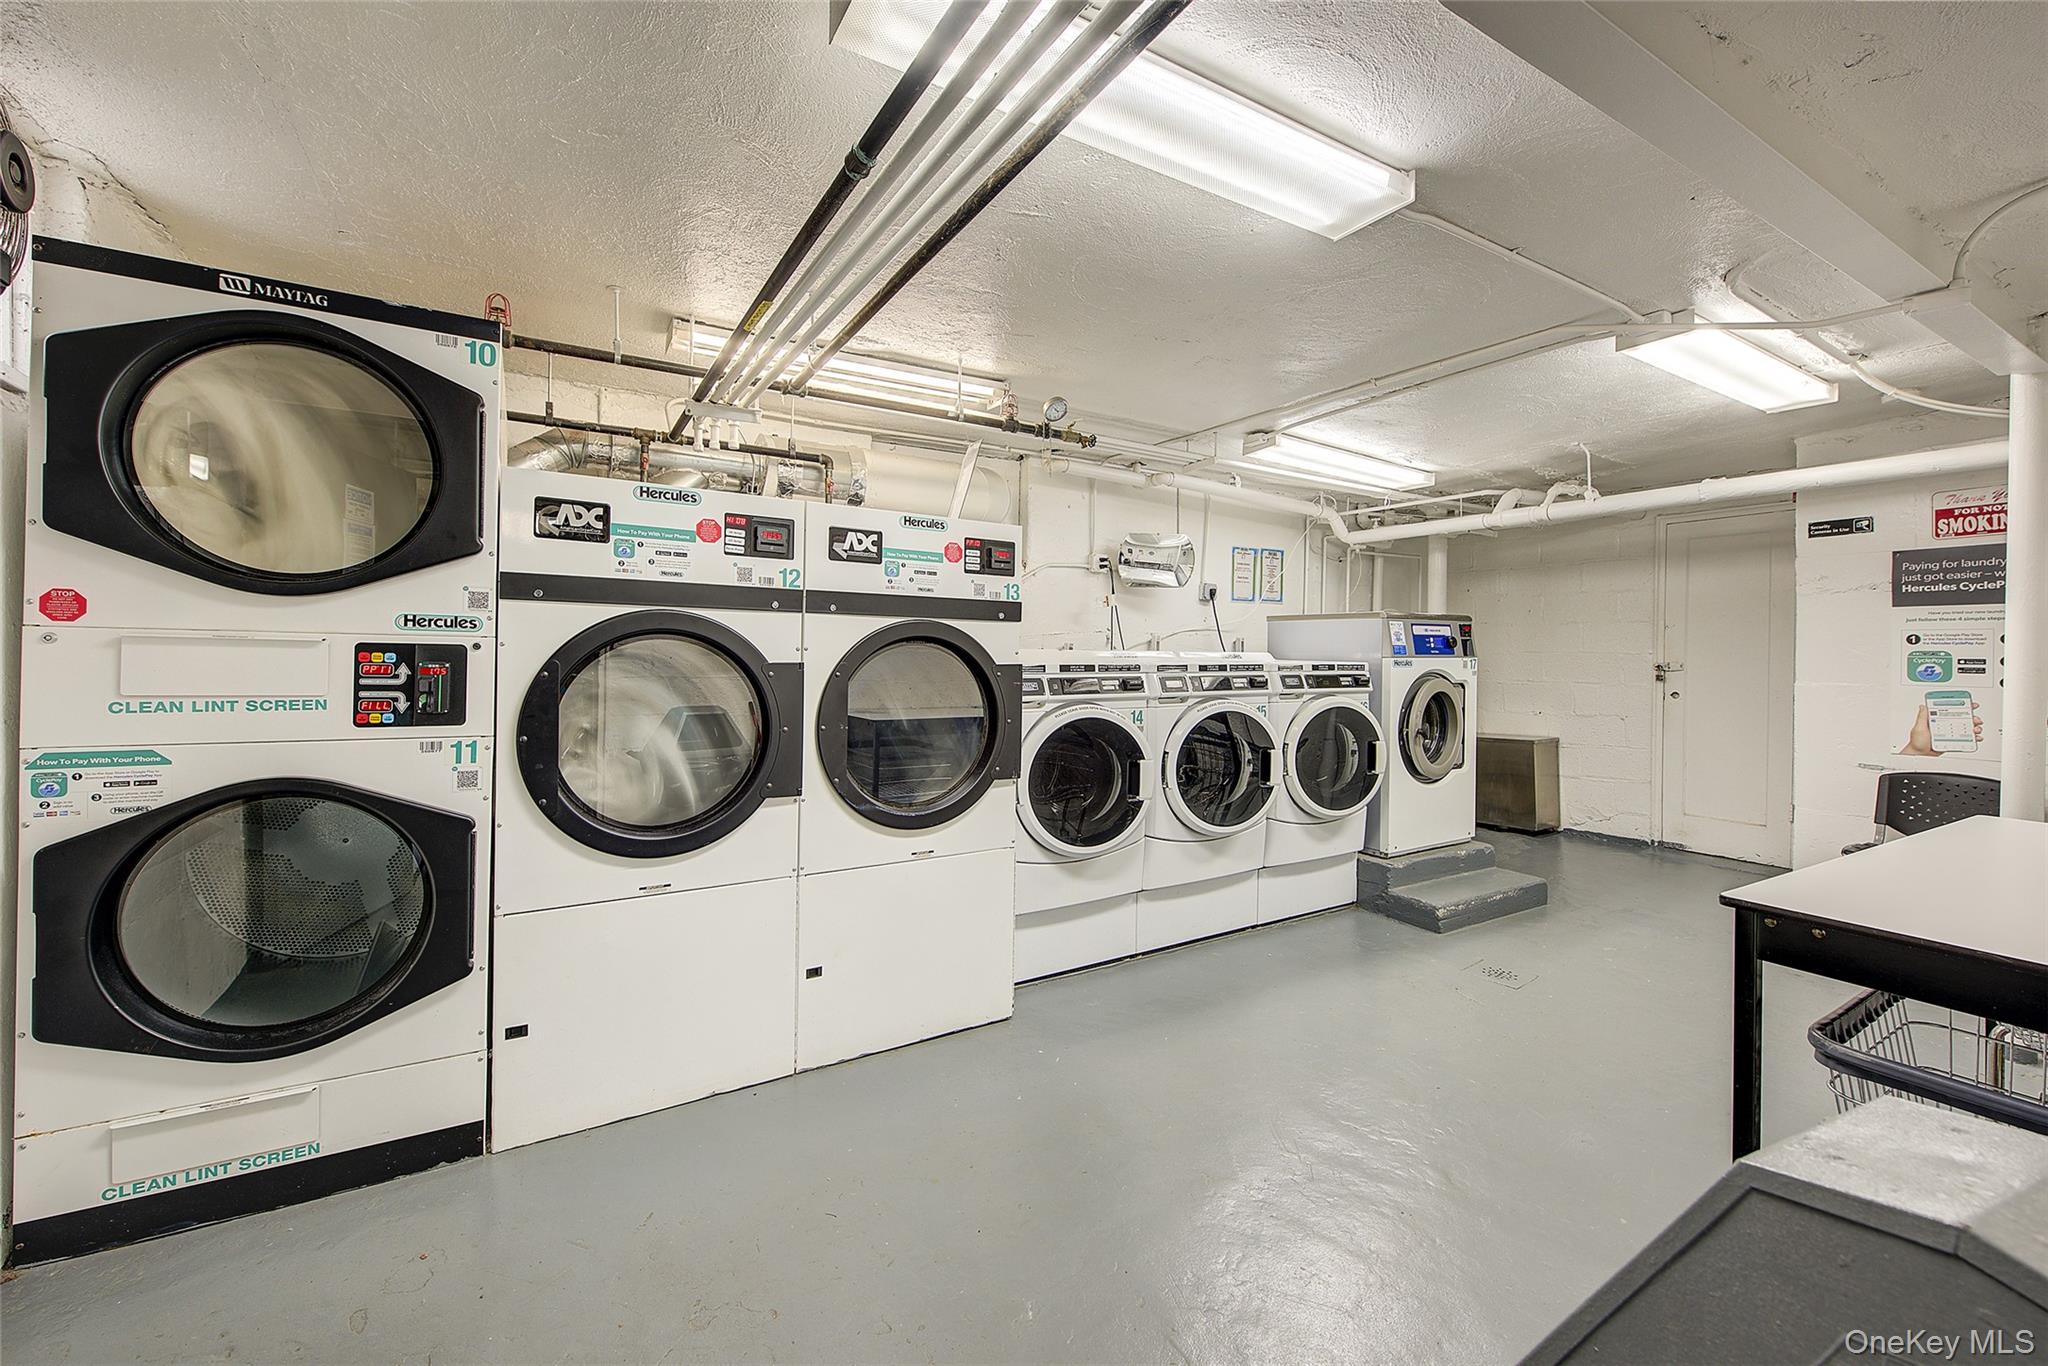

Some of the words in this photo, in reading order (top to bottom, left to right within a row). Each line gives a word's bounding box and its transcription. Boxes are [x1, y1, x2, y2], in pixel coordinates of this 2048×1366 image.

[254, 282, 328, 306] MAYTAG
[464, 340, 496, 366] 10
[640, 486, 697, 503] Hercules
[1944, 494, 1986, 505] Thank
[556, 504, 604, 529] ADC
[904, 516, 945, 530] Hercules
[843, 532, 878, 552] ADC
[1902, 562, 1939, 572] Paying
[1942, 560, 1959, 568] for
[1961, 557, 2006, 568] laundry
[779, 568, 801, 588] 12
[1902, 574, 1921, 583] just
[1924, 573, 1944, 582] got
[1004, 583, 1020, 600] 13
[1902, 583, 1957, 592] Hercules
[1960, 581, 2005, 592] CycleP
[404, 614, 478, 629] Hercules
[1470, 659, 1476, 669] 17
[108, 701, 184, 714] CLEAN
[192, 700, 239, 712] LINT
[245, 699, 327, 712] SCREEN
[1131, 710, 1144, 724] 14
[450, 741, 477, 764] 11
[101, 1174, 177, 1201] CLEAN
[184, 1162, 232, 1183] LINT
[238, 1143, 320, 1171] SCREEN
